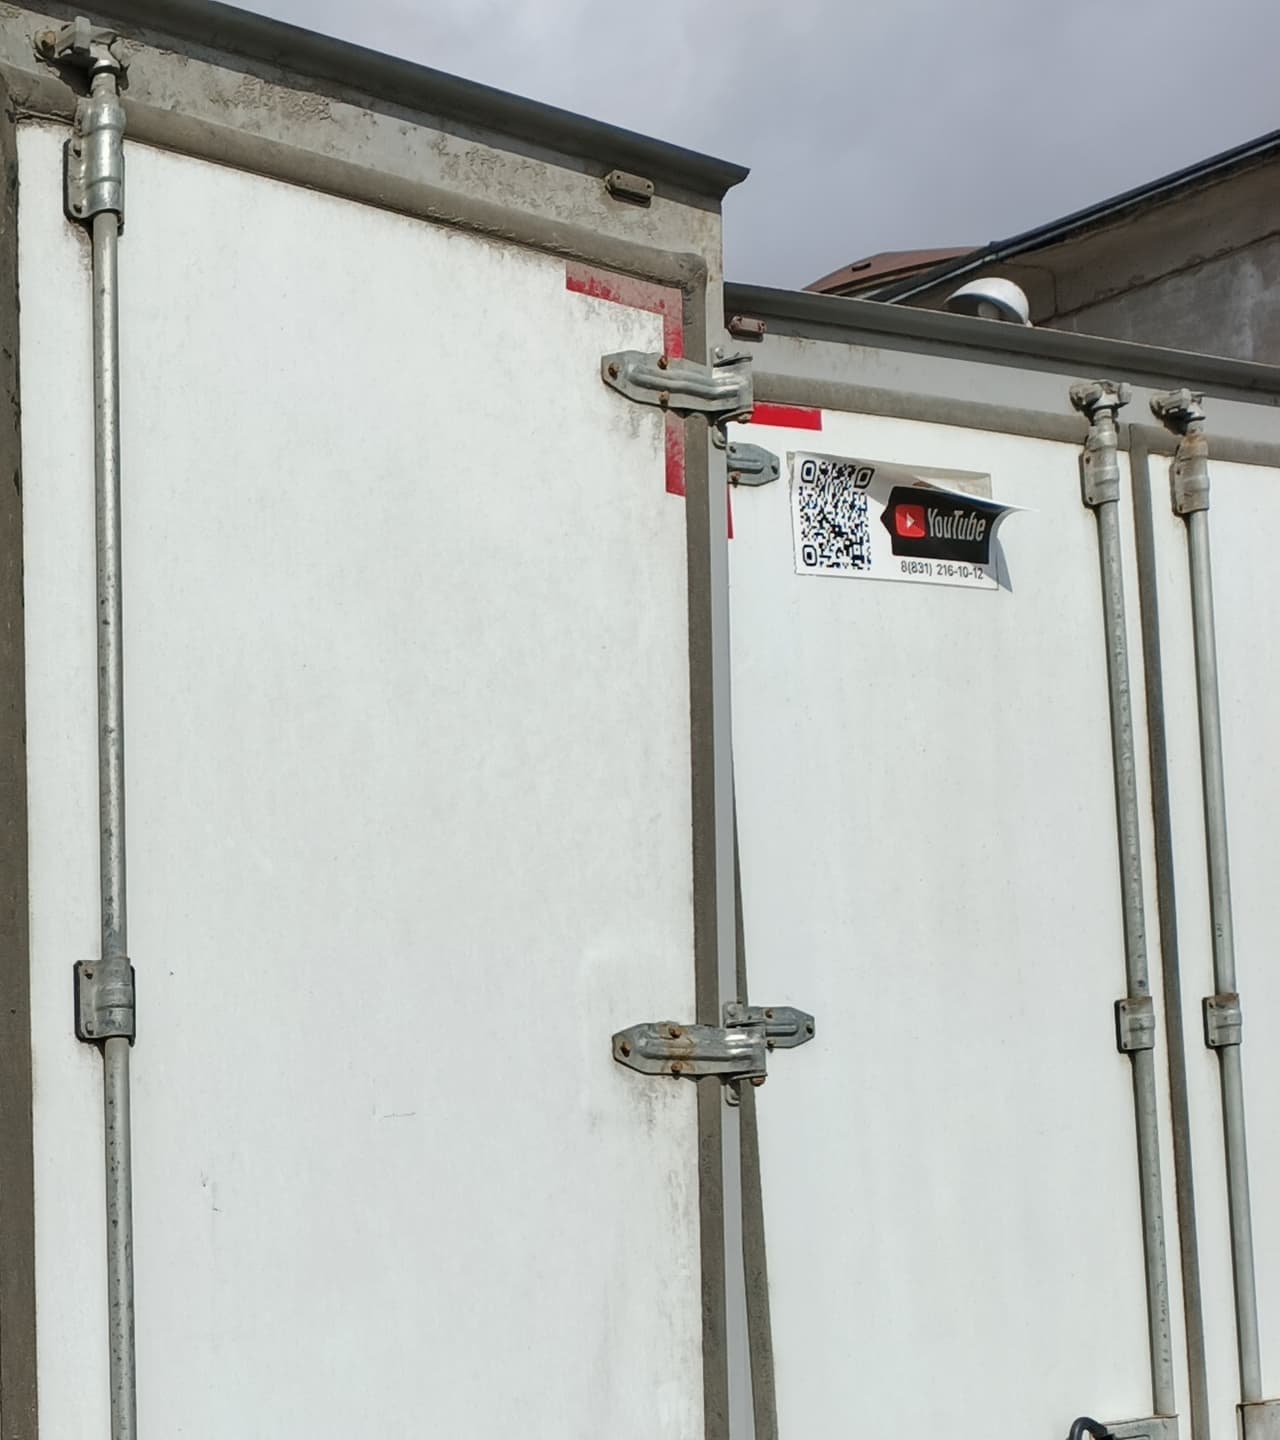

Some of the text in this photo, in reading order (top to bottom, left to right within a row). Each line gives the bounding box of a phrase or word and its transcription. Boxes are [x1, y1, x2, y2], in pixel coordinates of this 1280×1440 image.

[927, 508, 986, 541] YouTube
[900, 560, 984, 580] 8(831) 216-10-12
